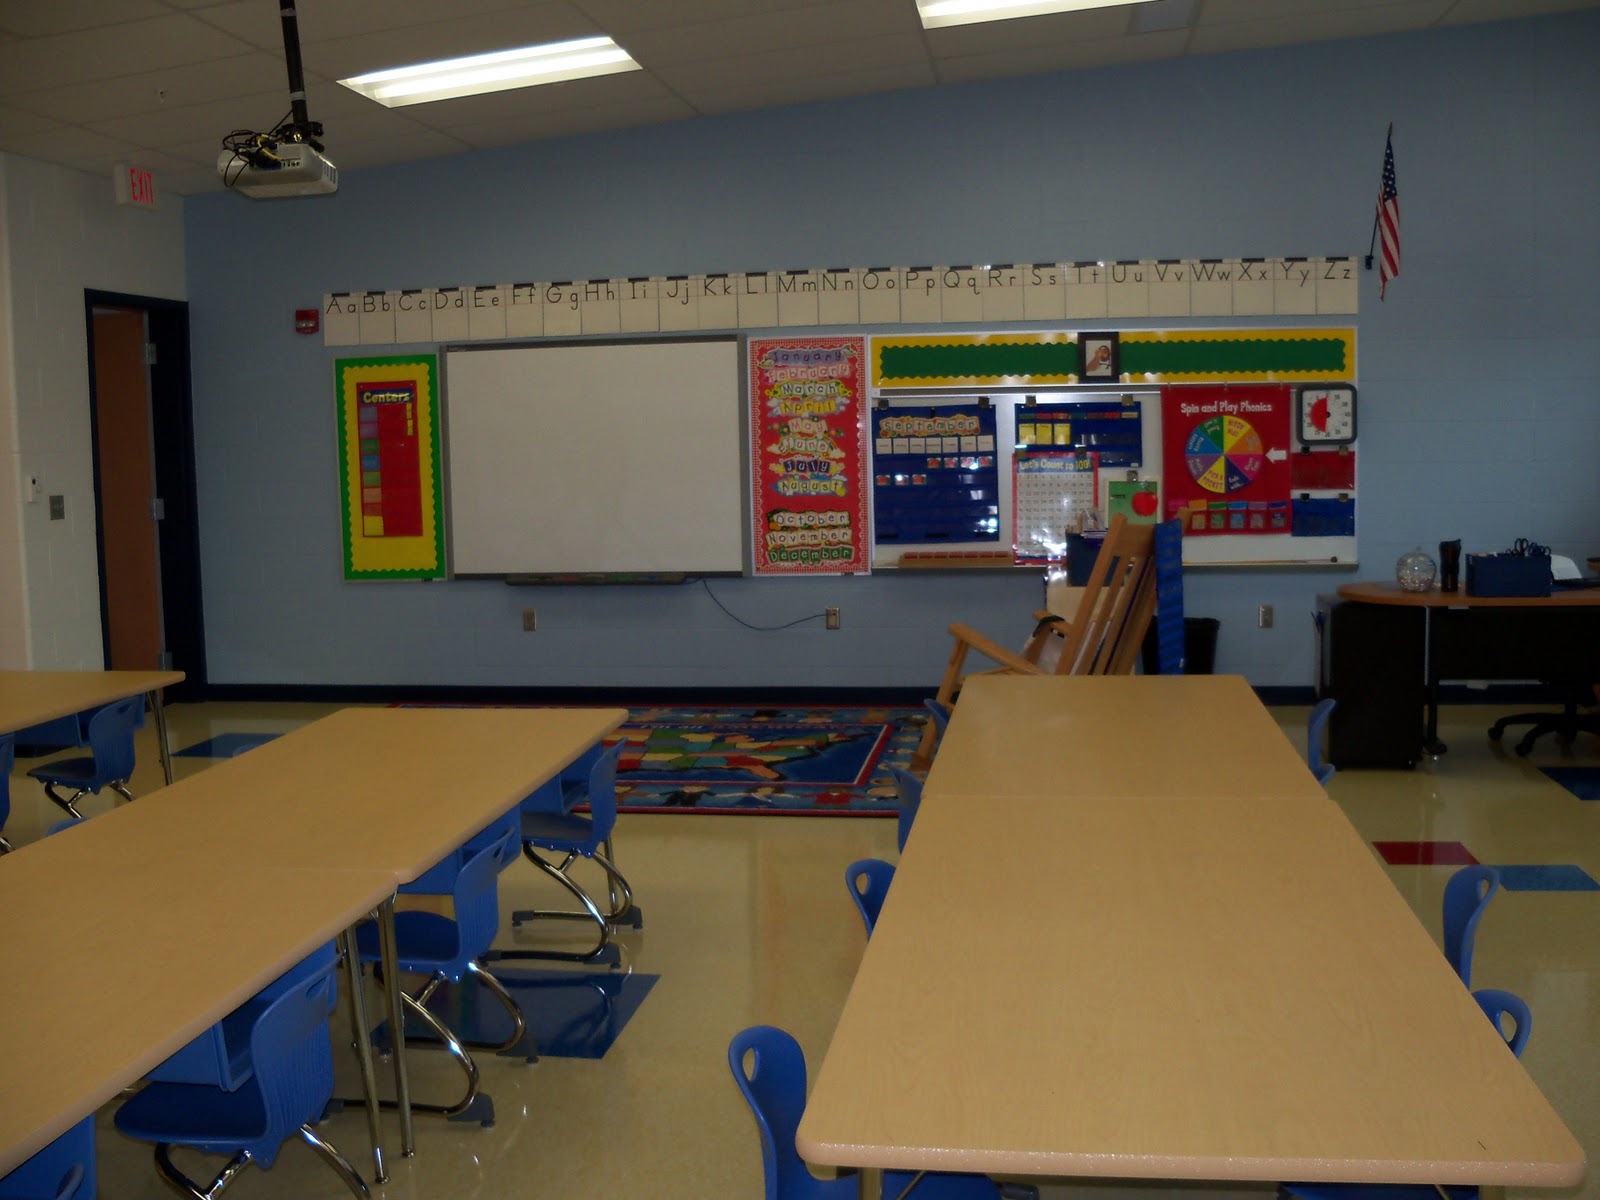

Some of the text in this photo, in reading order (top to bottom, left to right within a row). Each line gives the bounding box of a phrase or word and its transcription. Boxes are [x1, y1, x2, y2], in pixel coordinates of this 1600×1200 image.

[129, 167, 154, 204] EXIT
[772, 350, 842, 364] January
[769, 365, 849, 381] February
[782, 383, 838, 396] March
[363, 391, 410, 404] Centers
[782, 401, 834, 414] April
[1180, 400, 1272, 417] Spin and Play Phonics
[790, 421, 825, 433] May
[885, 419, 975, 431] September
[785, 438, 827, 452] June
[786, 460, 829, 472] July
[781, 480, 840, 493] August
[776, 513, 846, 526] October
[768, 531, 848, 545] November
[769, 550, 850, 562] December
